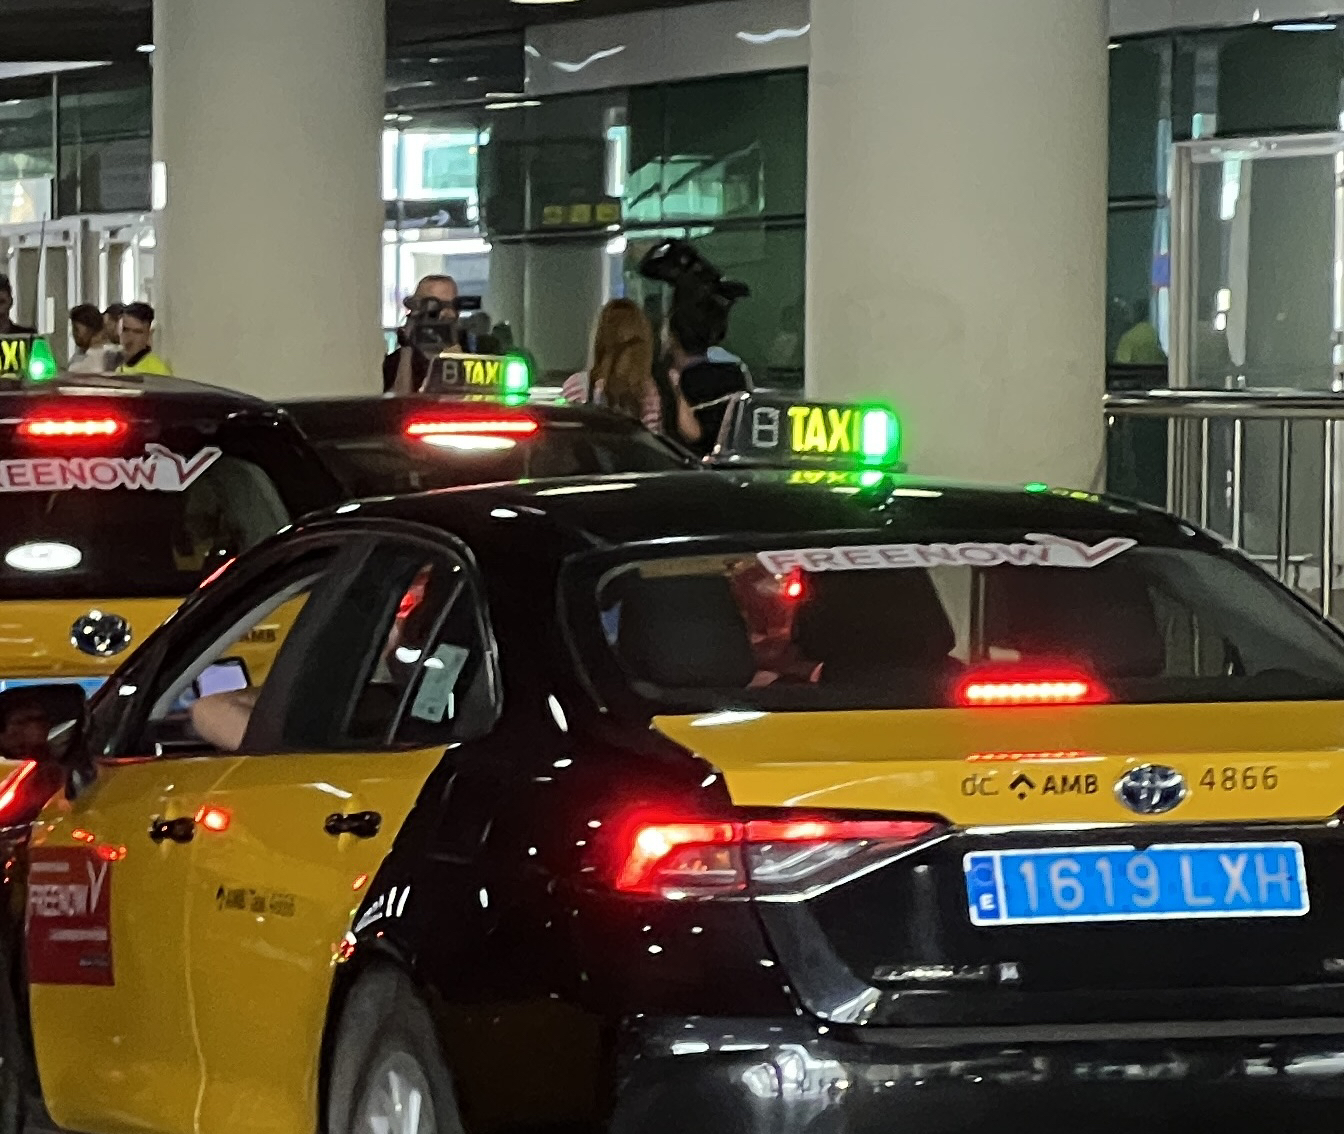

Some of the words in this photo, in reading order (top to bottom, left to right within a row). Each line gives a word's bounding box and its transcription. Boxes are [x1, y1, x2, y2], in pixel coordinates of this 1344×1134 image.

[787, 405, 861, 453] TAXI
[767, 543, 1050, 573] FREENOW
[1042, 774, 1099, 795] AMB
[1199, 765, 1279, 791] 4866
[979, 893, 995, 911] E
[1019, 854, 1160, 912] 1619
[1180, 852, 1292, 907] LXH
